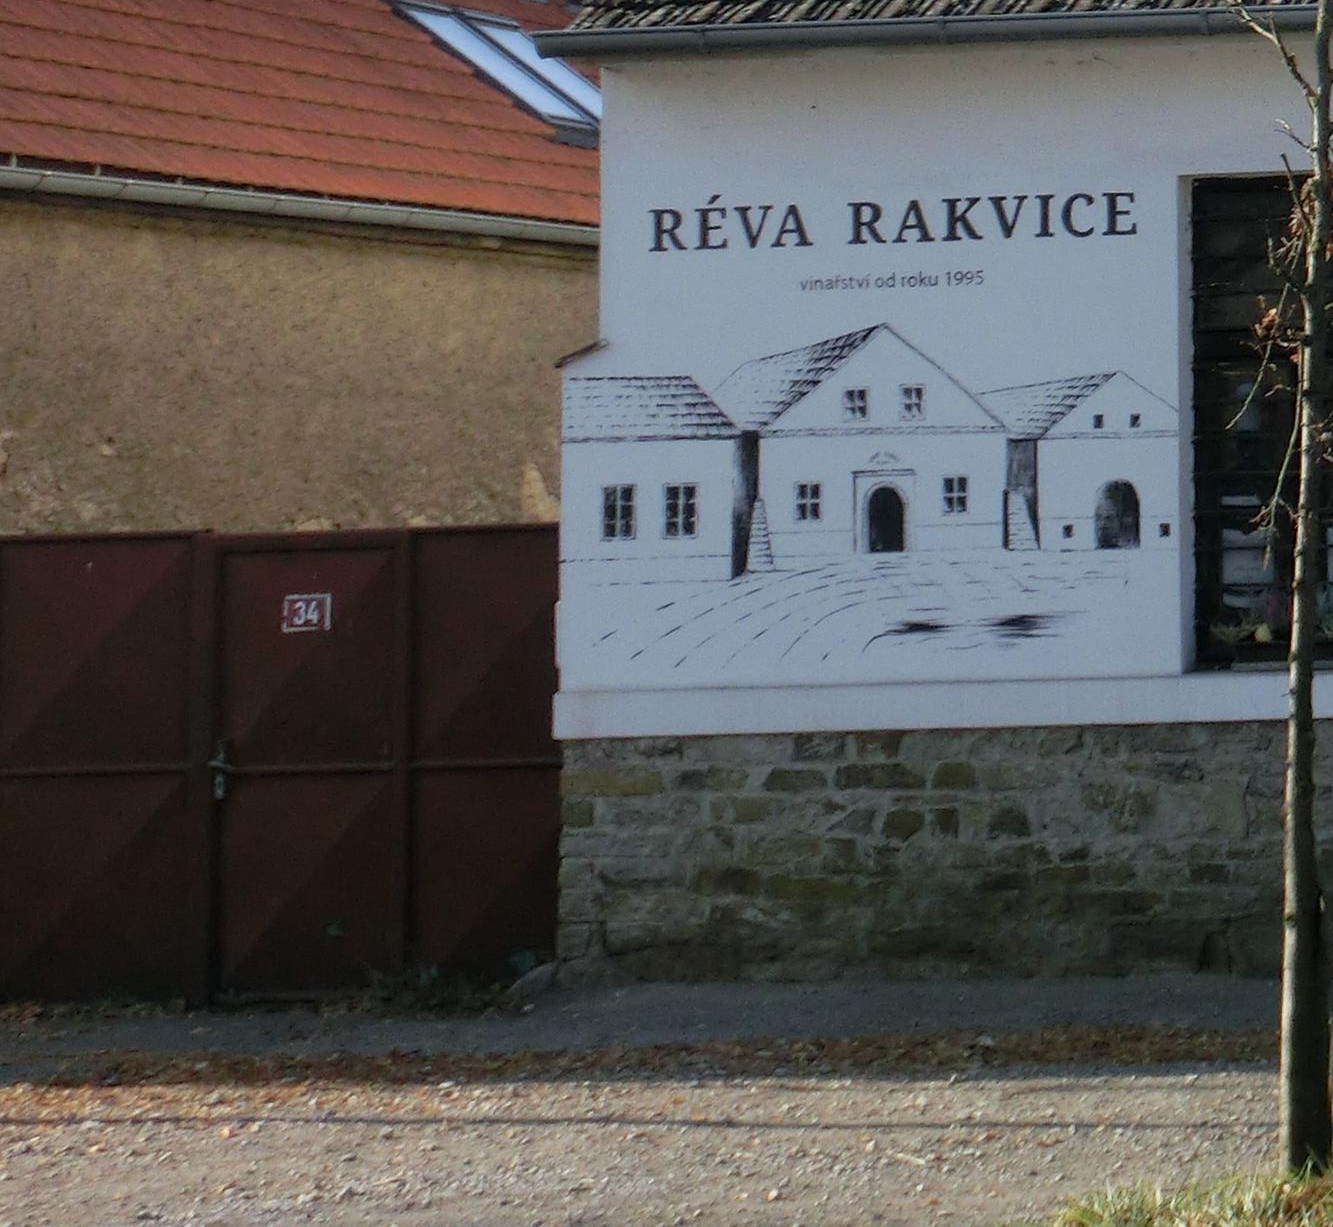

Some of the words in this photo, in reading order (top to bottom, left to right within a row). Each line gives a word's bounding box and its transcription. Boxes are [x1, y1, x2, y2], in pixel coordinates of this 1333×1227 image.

[649, 194, 814, 252] RÉVA
[847, 191, 1139, 245] RAKVICE
[874, 272, 896, 288] od
[901, 271, 939, 288] roku
[945, 270, 985, 286] 1995
[293, 600, 319, 625] 34
